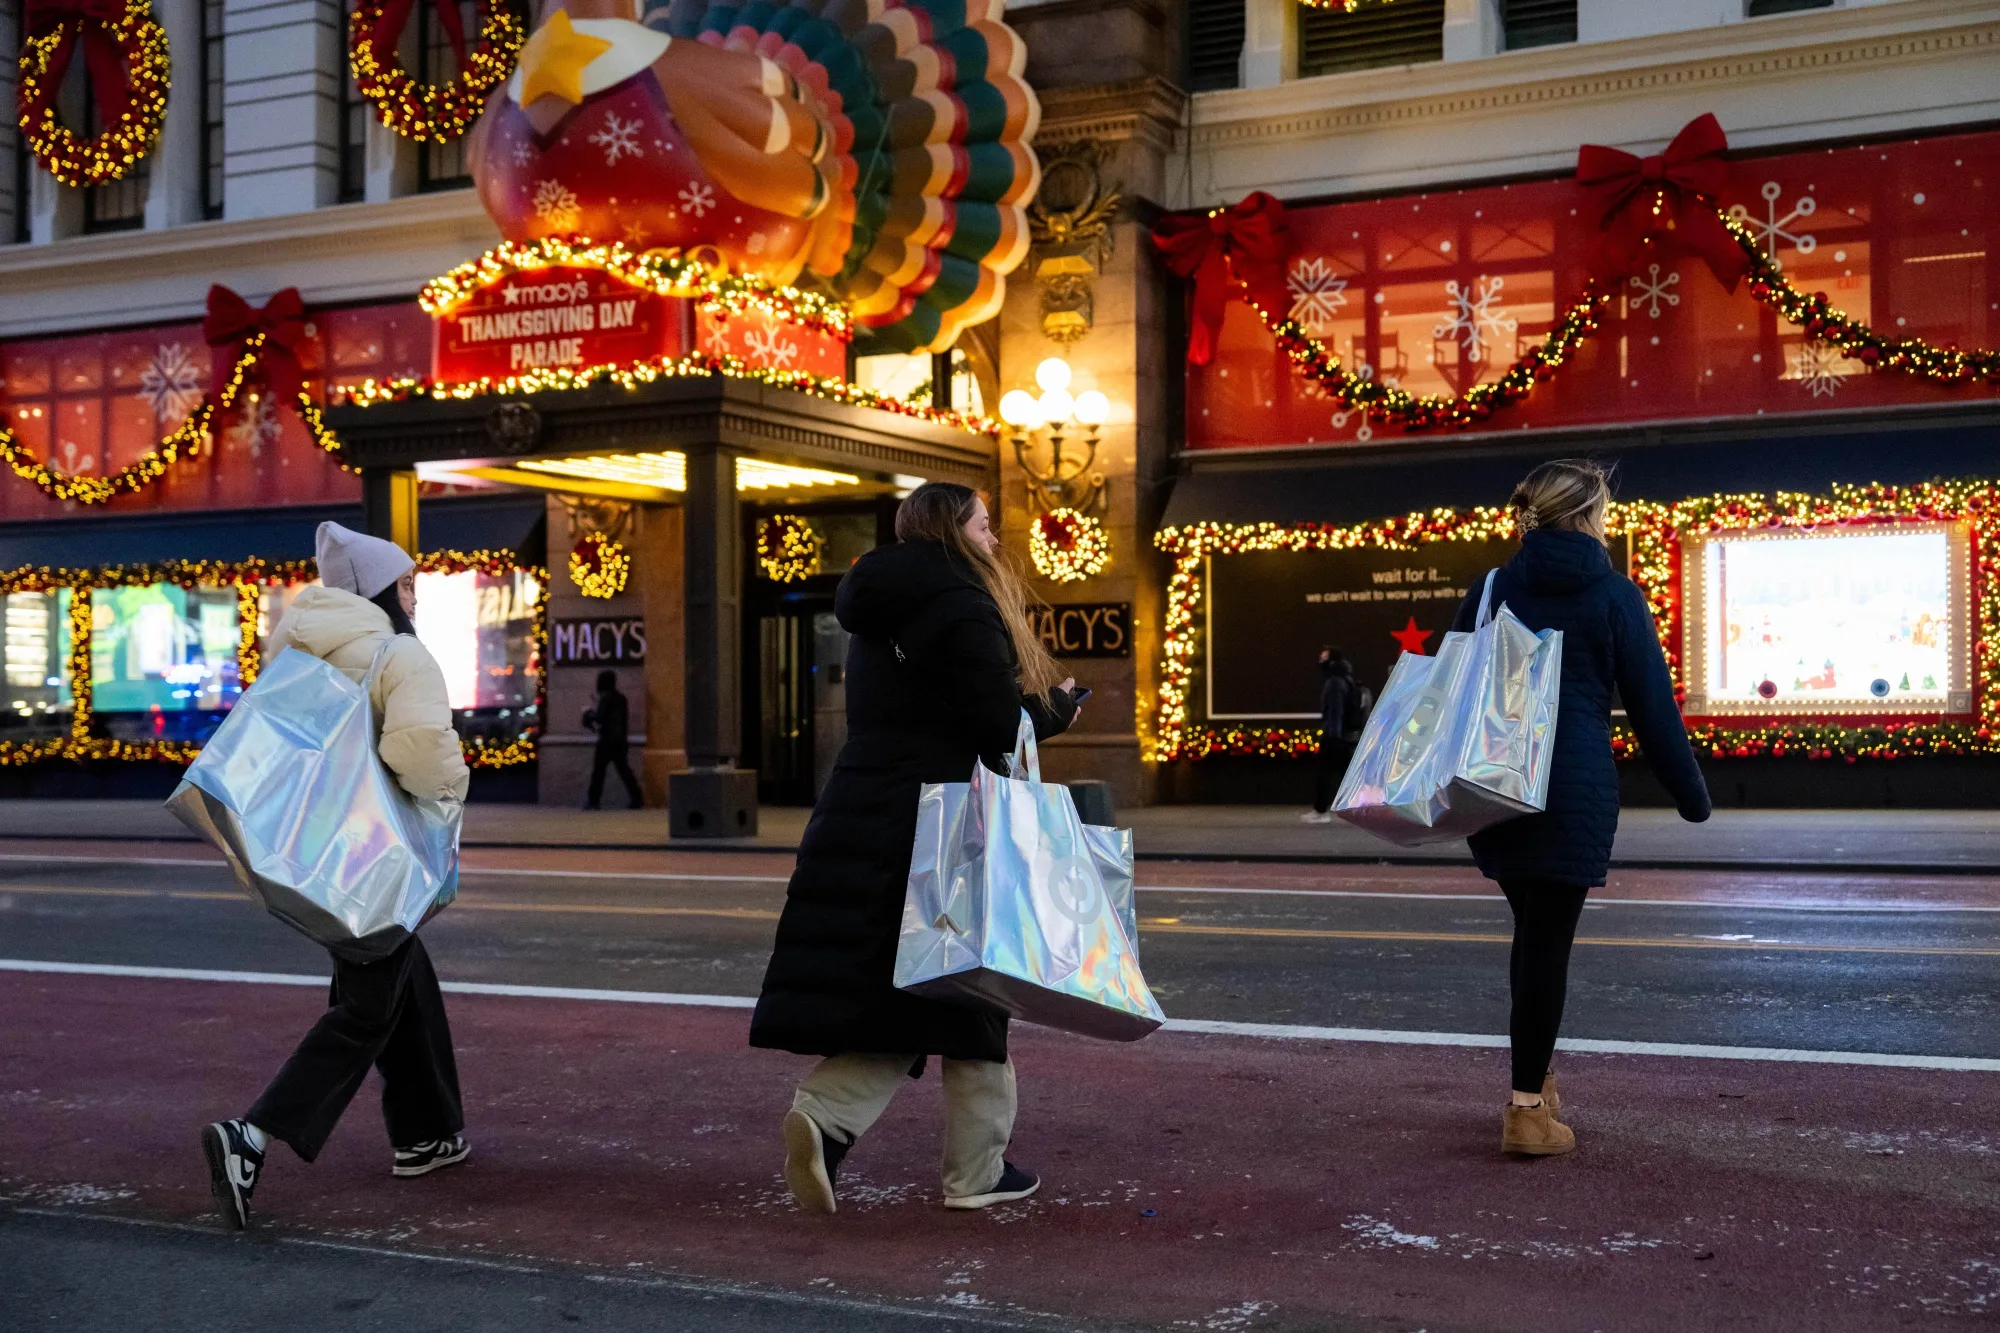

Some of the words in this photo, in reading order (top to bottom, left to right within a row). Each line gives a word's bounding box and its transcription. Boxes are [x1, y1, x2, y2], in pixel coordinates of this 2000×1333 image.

[520, 274, 589, 305] macy's
[459, 304, 595, 343] THANKSGIVING
[599, 299, 637, 329] DAY
[510, 337, 585, 371] PARADE
[1372, 568, 1402, 584] wait
[1405, 567, 1426, 582] for
[1305, 592, 1322, 603] we
[1323, 590, 1349, 603] can't
[1350, 589, 1372, 601] wait
[1373, 589, 1384, 601] to
[1385, 590, 1410, 600] wow
[1411, 590, 1432, 602] you
[1433, 586, 1456, 600] with
